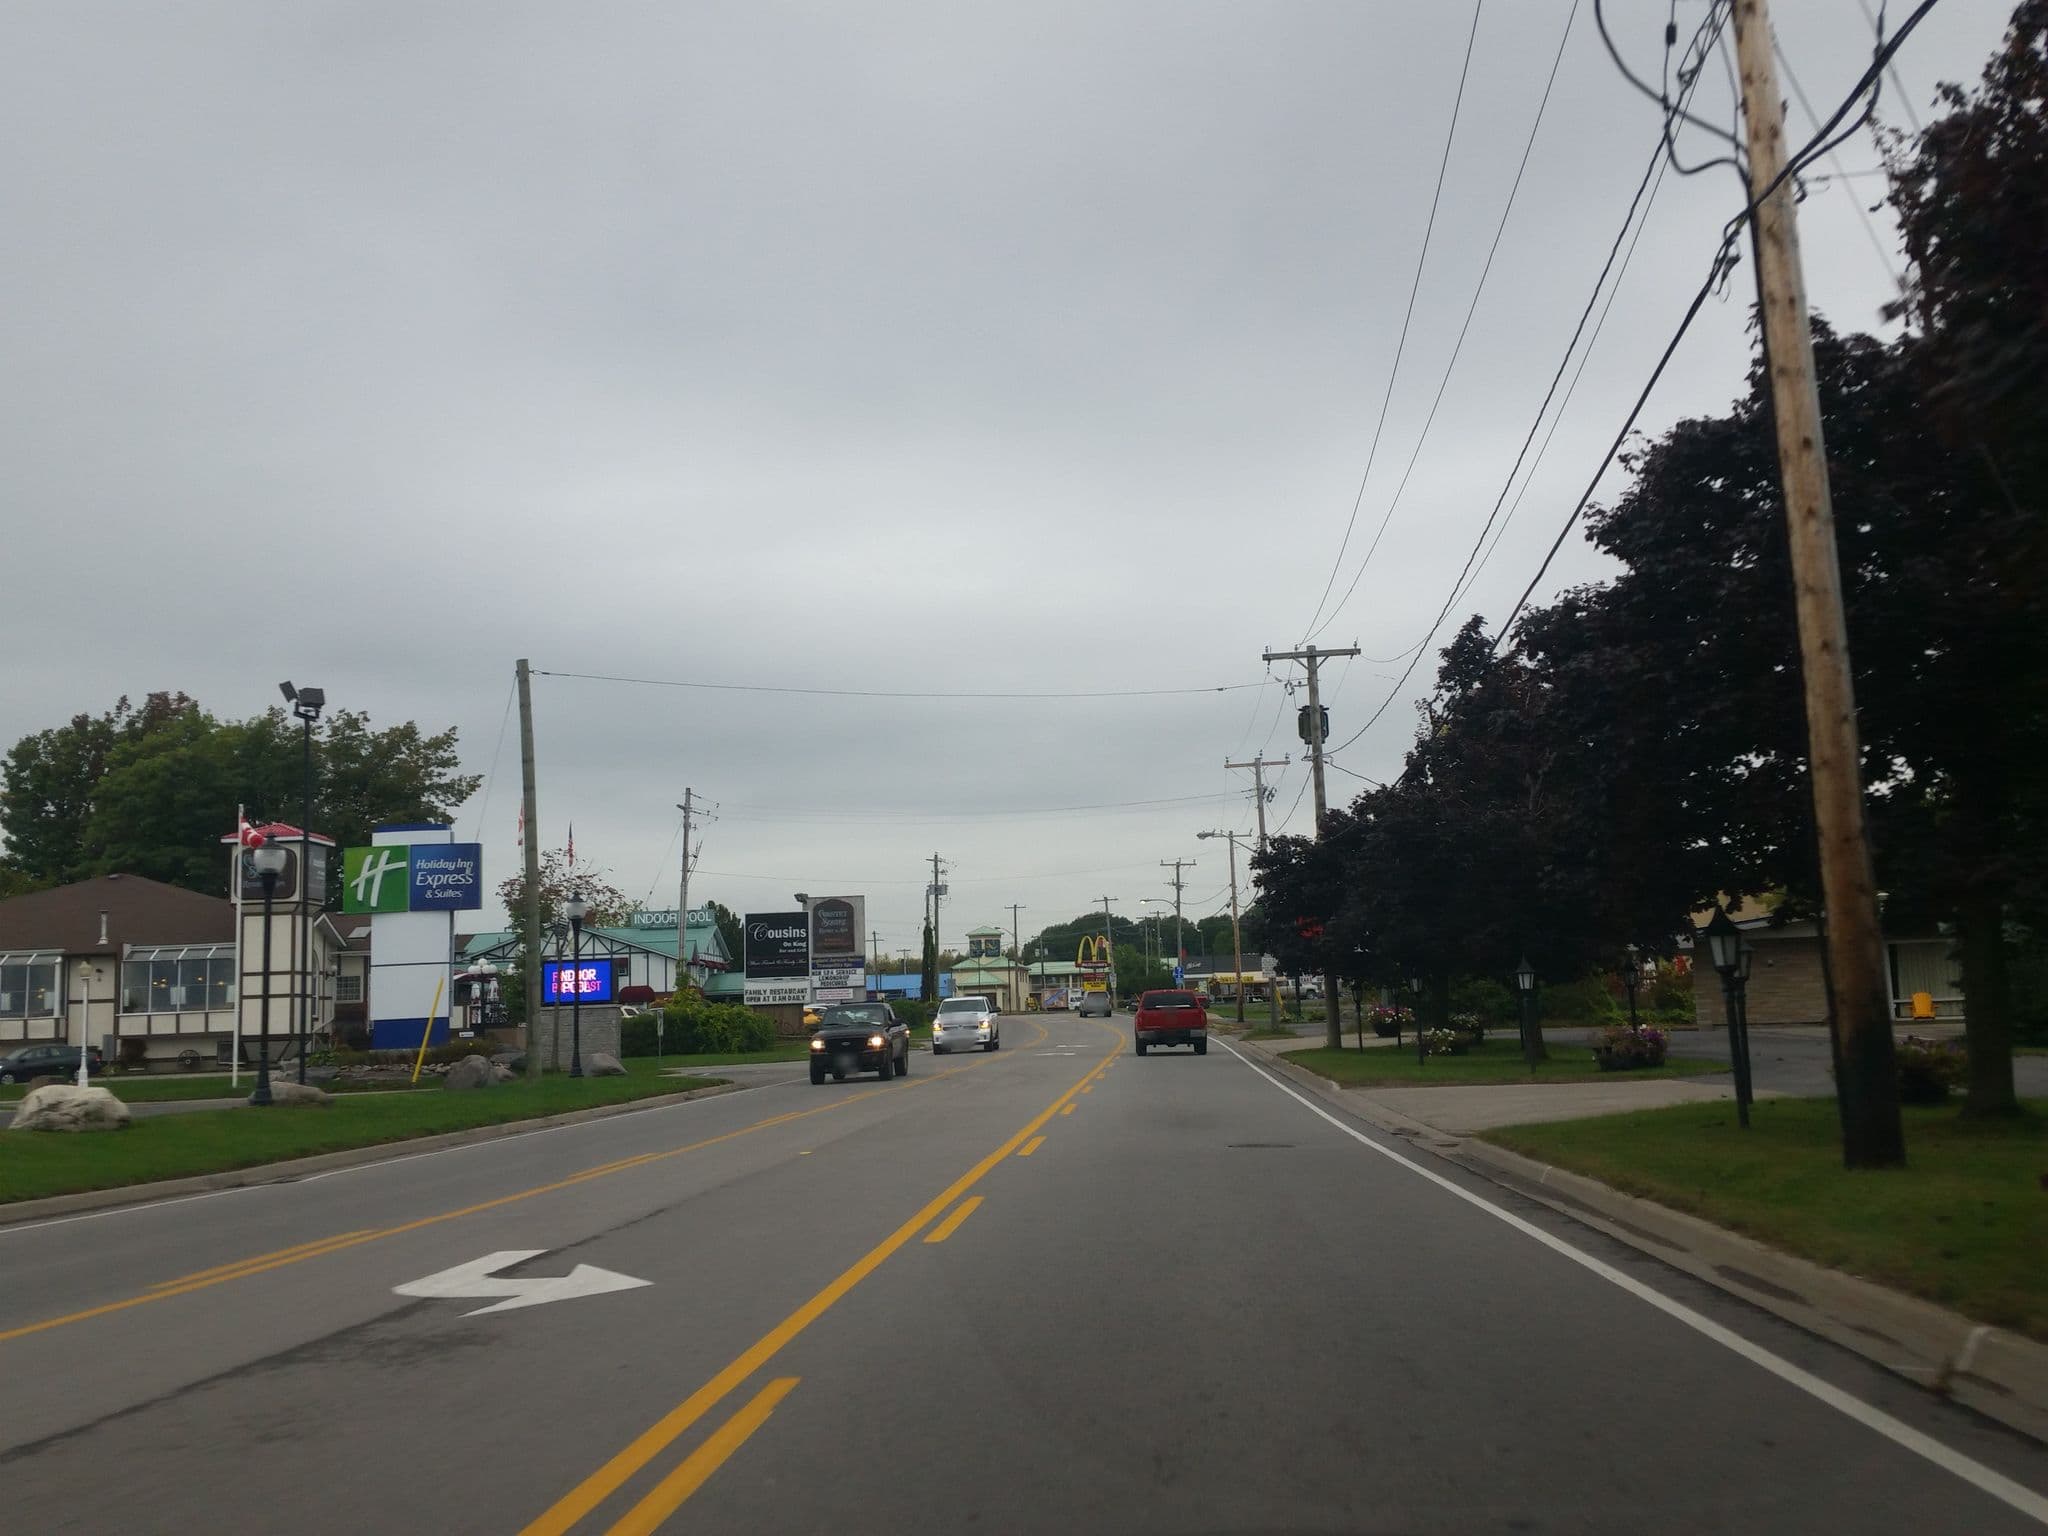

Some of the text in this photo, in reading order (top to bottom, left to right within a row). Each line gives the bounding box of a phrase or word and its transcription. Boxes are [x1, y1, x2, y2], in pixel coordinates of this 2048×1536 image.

[416, 857, 473, 871] Holiday Inn
[416, 871, 473, 888] Express
[425, 889, 463, 898] & Suites
[634, 911, 712, 924] INDOOR OOL
[748, 922, 807, 941] Cousins
[769, 988, 808, 996] RESTAURANT
